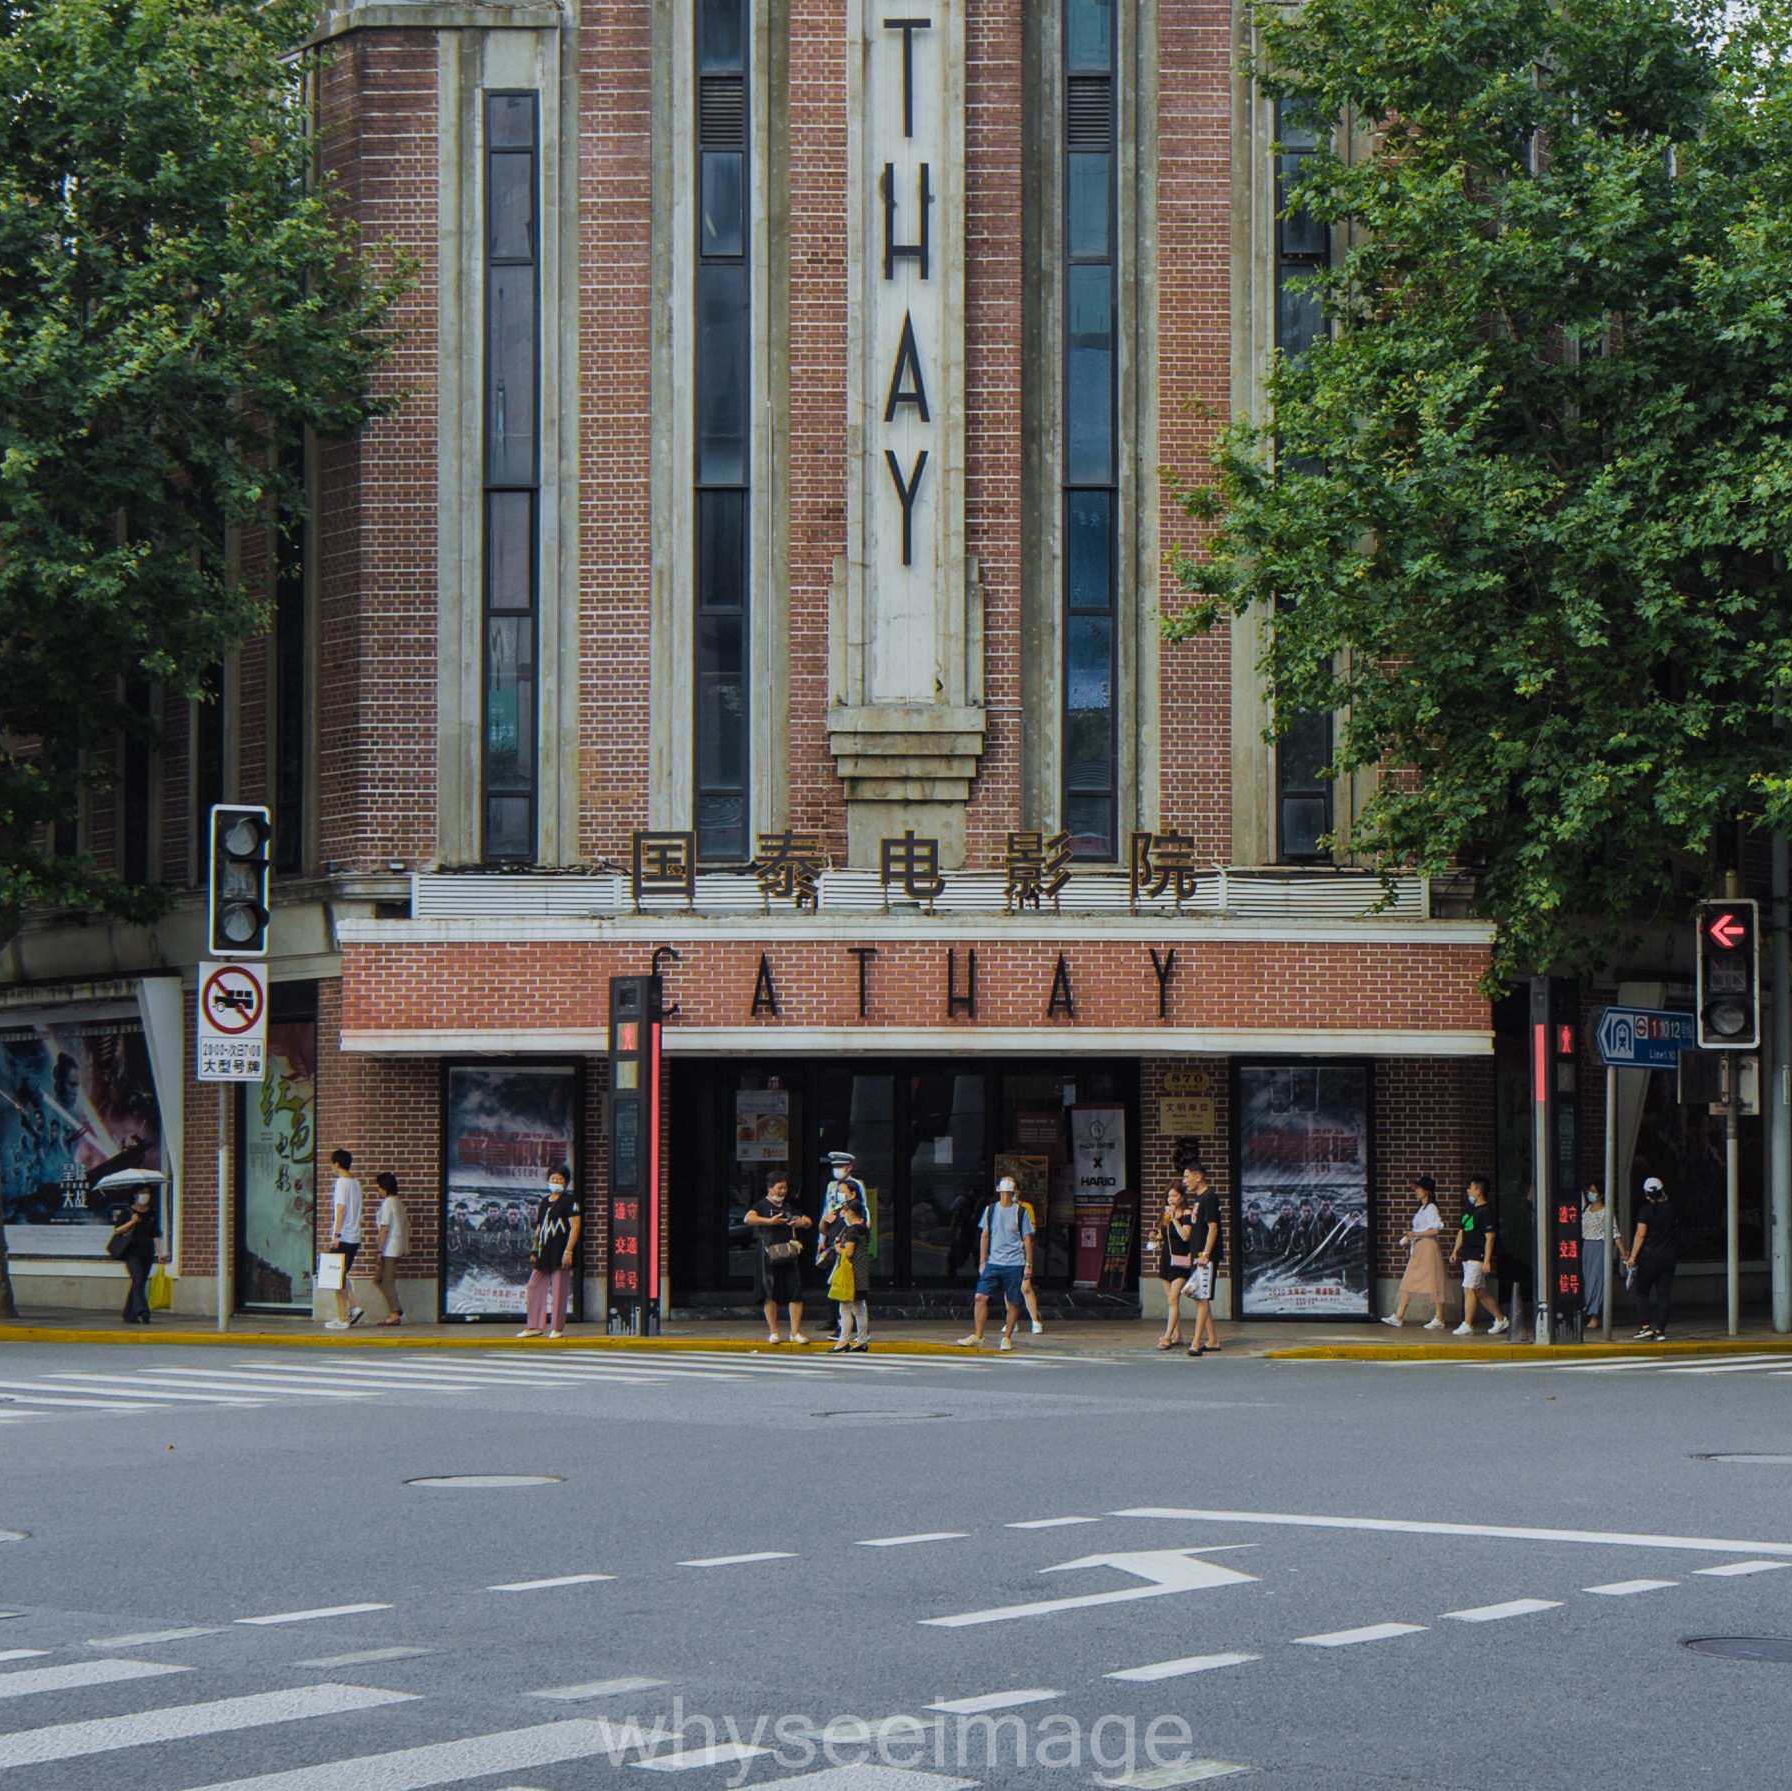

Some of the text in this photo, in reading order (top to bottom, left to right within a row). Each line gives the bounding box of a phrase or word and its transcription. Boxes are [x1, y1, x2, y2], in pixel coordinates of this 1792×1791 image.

[631, 828, 1198, 899] 国泰电影院
[202, 1058, 261, 1074] 大型号牌
[1171, 1074, 1204, 1083] 870
[1165, 1102, 1209, 1113] 文明单位
[1080, 1176, 1117, 1187] HARIO
[62, 1189, 89, 1208] 大战
[613, 1236, 639, 1255] 交通
[1558, 1240, 1578, 1259] 交通
[613, 1270, 639, 1290] 信号
[1558, 1274, 1580, 1295] 信号
